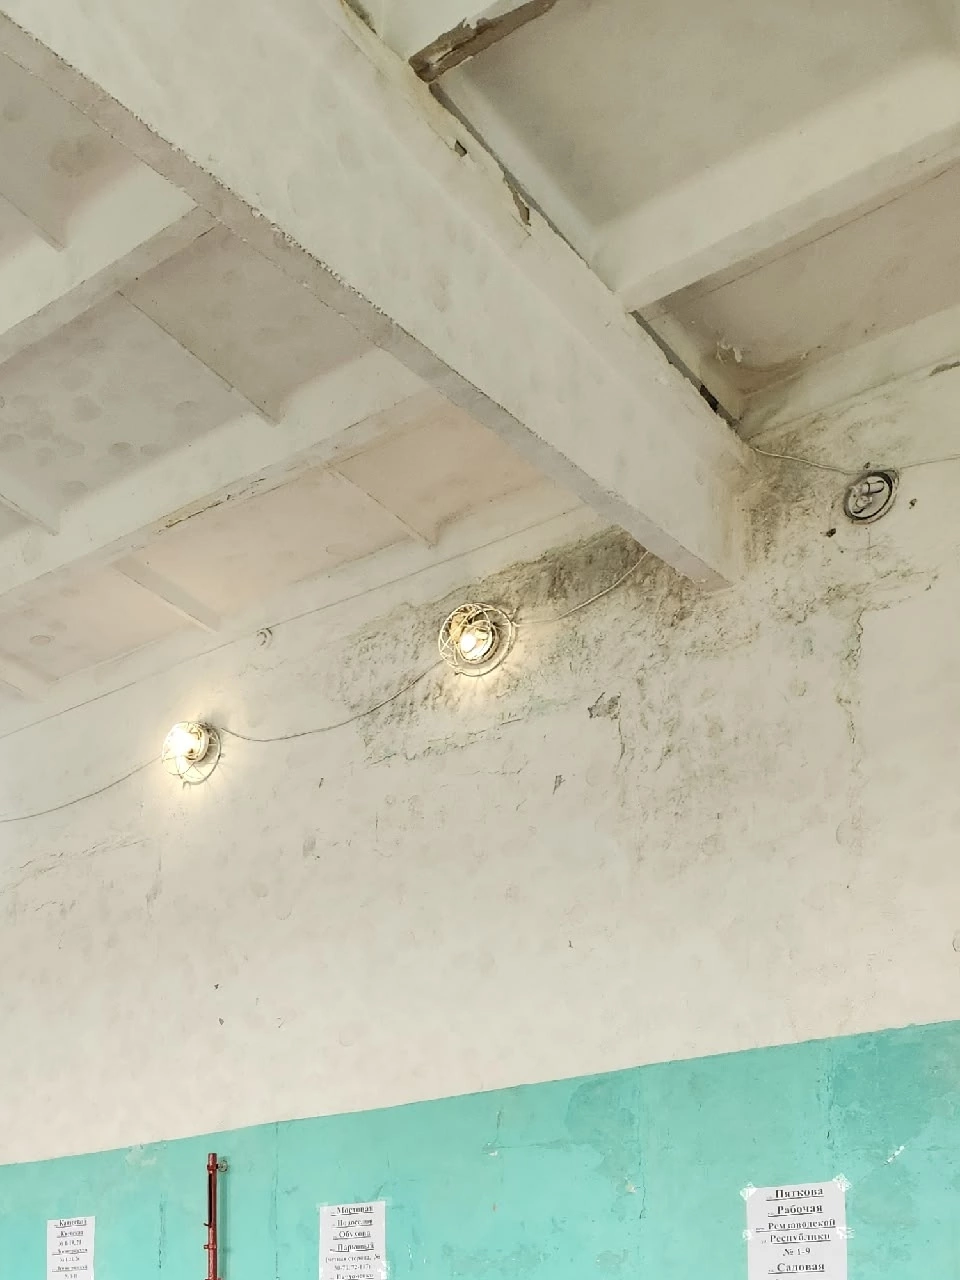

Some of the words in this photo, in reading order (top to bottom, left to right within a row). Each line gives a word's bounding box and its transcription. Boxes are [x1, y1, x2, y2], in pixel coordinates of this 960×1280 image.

[775, 1189, 823, 1198] Пяткова
[777, 1205, 823, 1214] Рабочая
[770, 1233, 830, 1243] Республики
[797, 1247, 811, 1255] 1-9
[777, 1263, 825, 1272] Садовая
